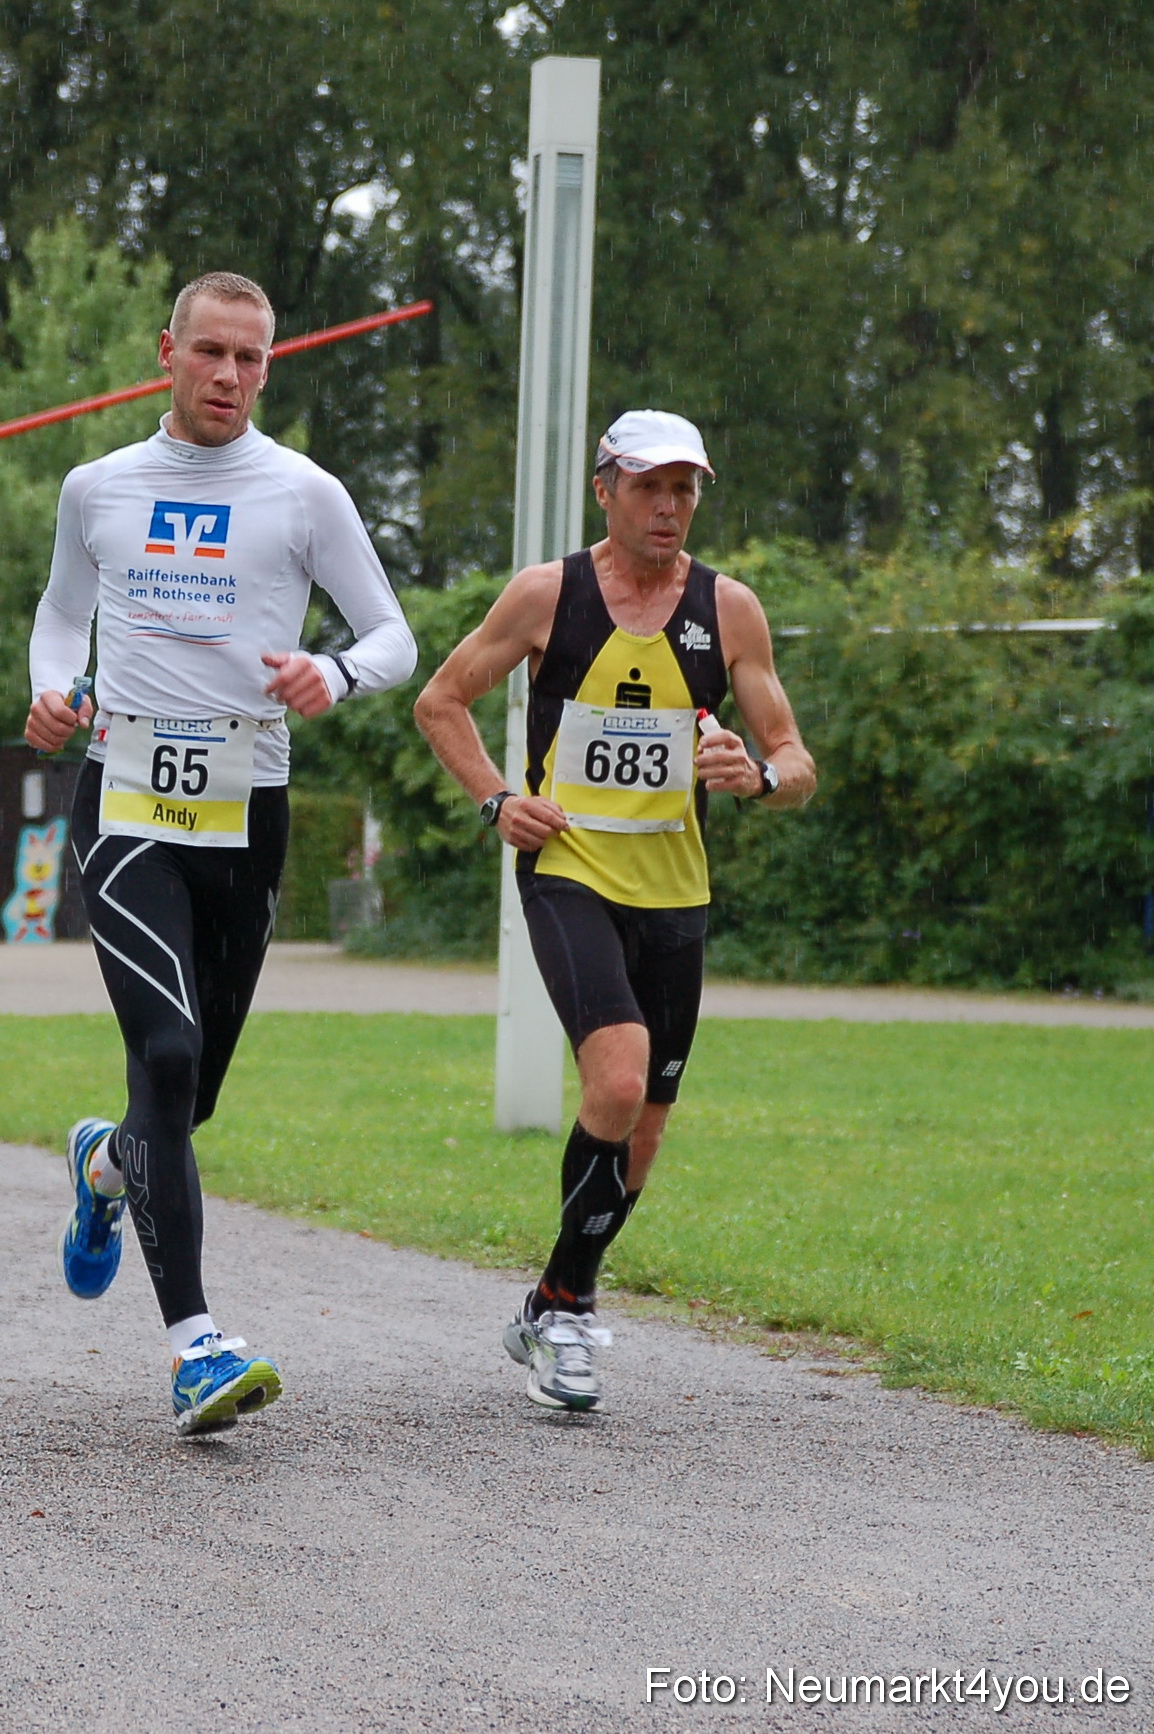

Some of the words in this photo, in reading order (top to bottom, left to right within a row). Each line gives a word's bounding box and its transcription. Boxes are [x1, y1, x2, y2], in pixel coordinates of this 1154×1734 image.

[128, 568, 236, 588] Raiffeisenbank
[128, 588, 147, 598] am
[153, 587, 211, 602] Rothsee
[216, 593, 236, 604] eG
[154, 719, 213, 734] BOCK
[603, 716, 659, 730] BOCK
[151, 745, 209, 796] 65
[585, 740, 670, 788] 683
[153, 803, 198, 831] Andy
